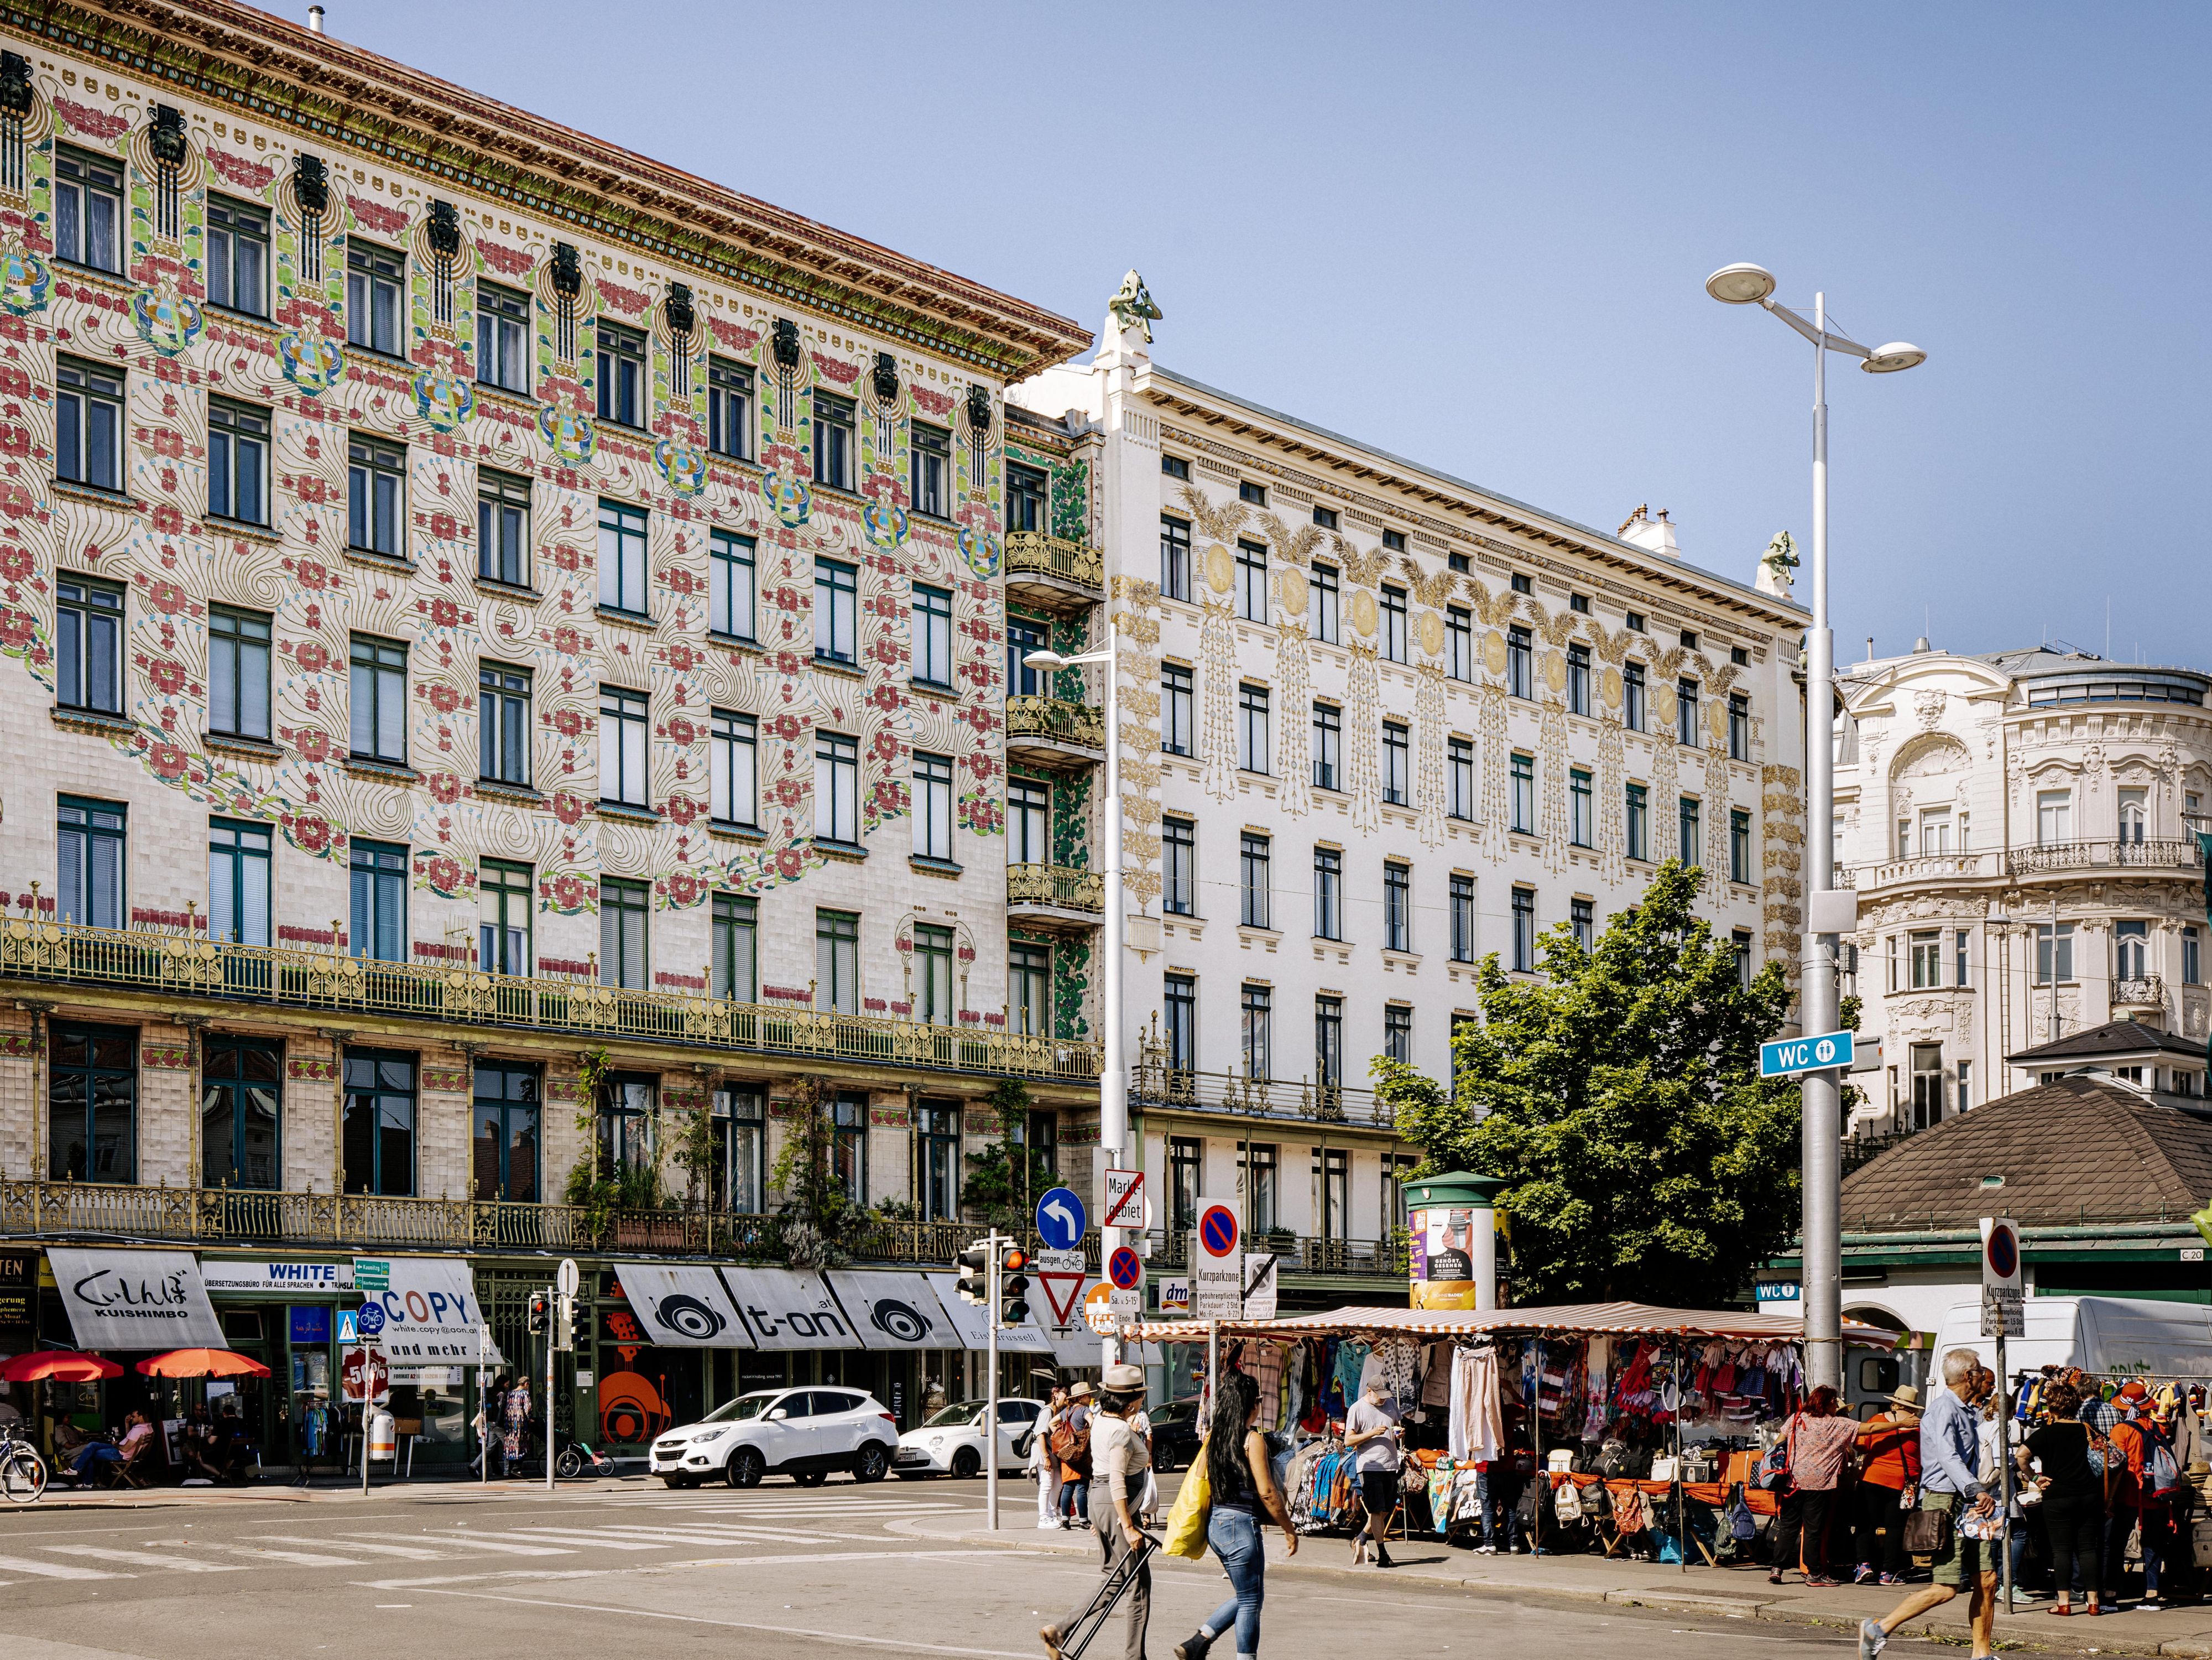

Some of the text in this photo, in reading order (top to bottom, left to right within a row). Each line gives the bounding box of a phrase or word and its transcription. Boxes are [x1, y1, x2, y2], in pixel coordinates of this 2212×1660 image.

[1778, 1044, 1808, 1068] WC
[1109, 1178, 1141, 1195] Markt-
[1109, 1201, 1141, 1219] gebiet
[2182, 1250, 2202, 1259] C 20
[1040, 1256, 1062, 1266] ausgen.
[269, 1264, 335, 1280] WHITE
[1198, 1268, 1239, 1284] Kurzparkzone
[205, 1278, 260, 1288] ÜBERSETZUNGSBÜRO
[262, 1280, 272, 1288] FÜR
[1166, 1283, 1188, 1300] dm
[1199, 1292, 1239, 1301] gebührenpflichtig
[1760, 1283, 1780, 1298] WC
[1986, 1283, 2020, 1300] Kurzparkzone
[818, 1298, 833, 1309] .at
[1111, 1295, 1120, 1304] Sa.
[382, 1290, 469, 1324] COPY
[95, 1309, 188, 1319] KUISHIMBO
[747, 1305, 846, 1338] t-on
[392, 1325, 478, 1335] white.copy@aon.at
[972, 1331, 1036, 1342] Eisarussell
[391, 1344, 421, 1355] und
[427, 1344, 467, 1356] mehr
[1464, 1499, 1481, 1509] STA
[1458, 1507, 1483, 1519] WAR
